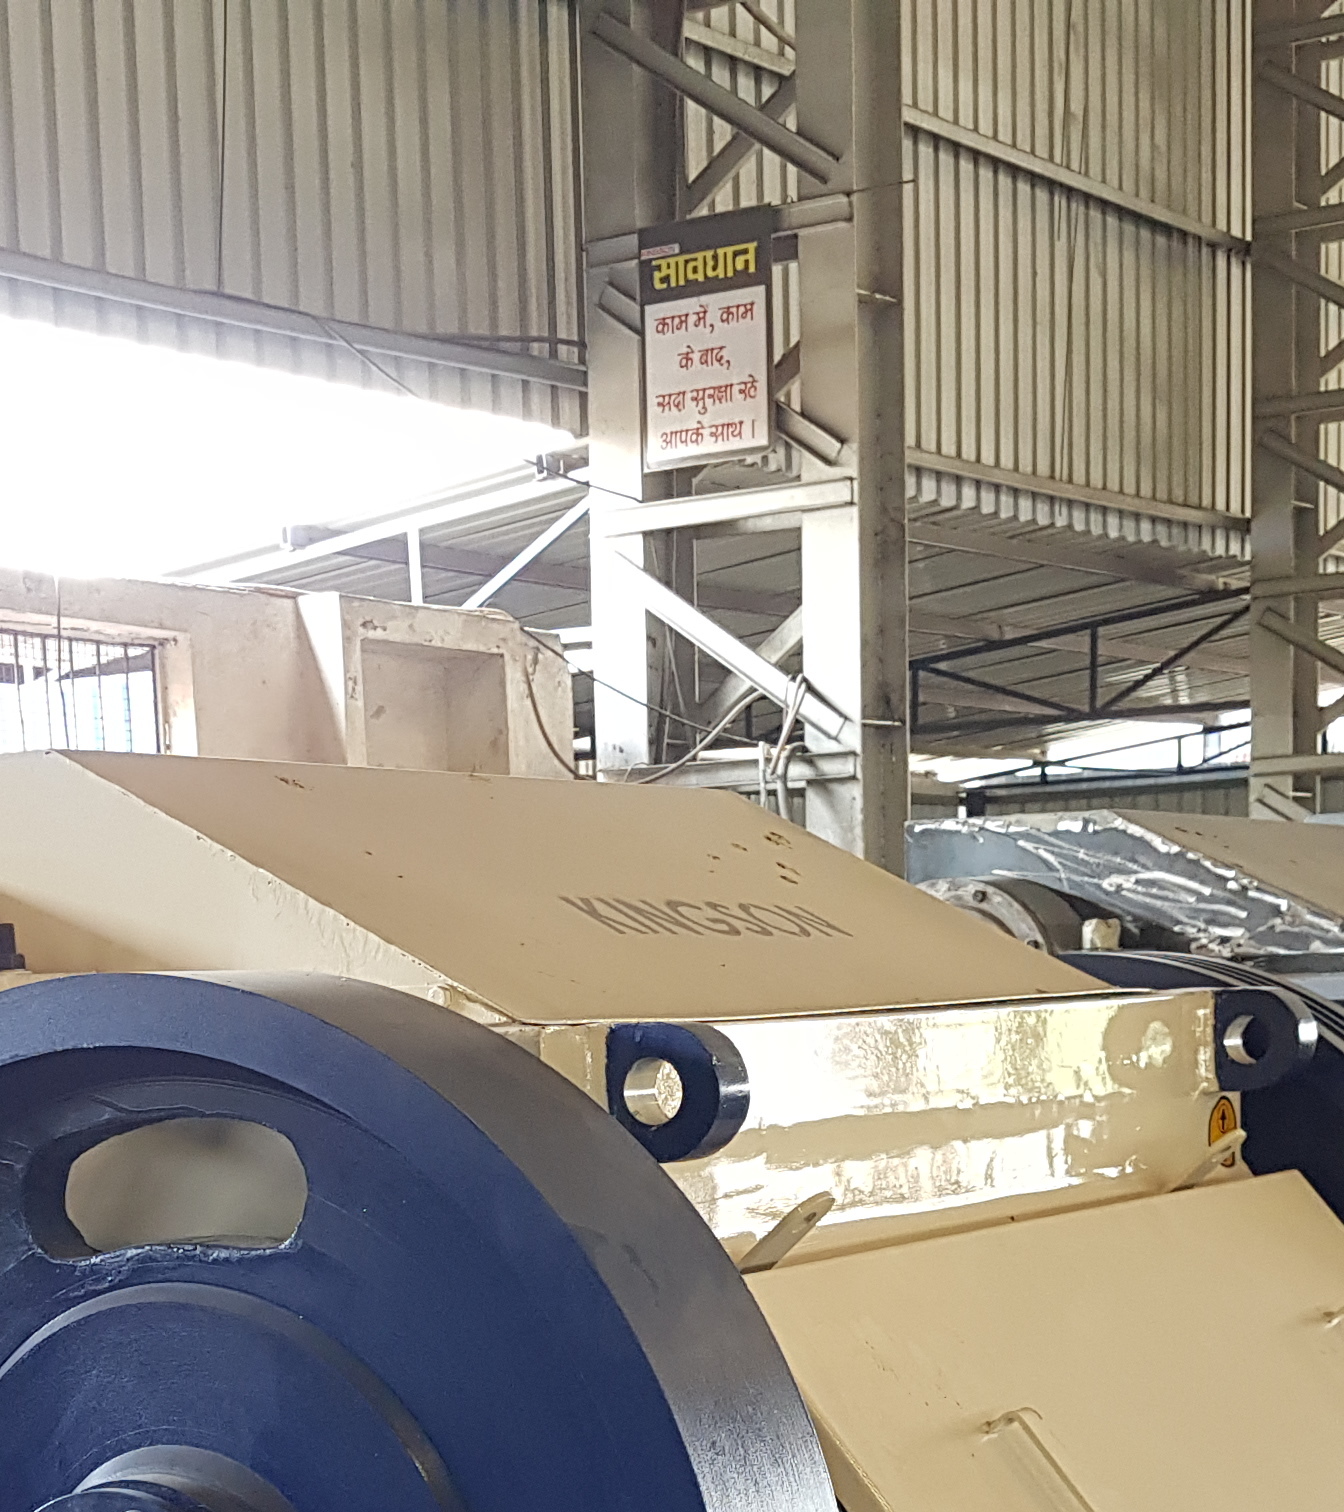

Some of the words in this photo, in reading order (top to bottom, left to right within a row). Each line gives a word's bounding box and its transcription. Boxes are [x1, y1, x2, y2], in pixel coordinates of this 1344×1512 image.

[651, 241, 758, 290] सावधान
[654, 313, 689, 335] काम
[692, 304, 714, 334] में,
[718, 301, 755, 325] काम
[677, 345, 695, 370] के
[697, 345, 731, 370] बाद,
[655, 391, 686, 413] सदा
[690, 384, 734, 415] सुरक्षा
[661, 420, 704, 450] आपके
[558, 896, 854, 937] KINGSON
